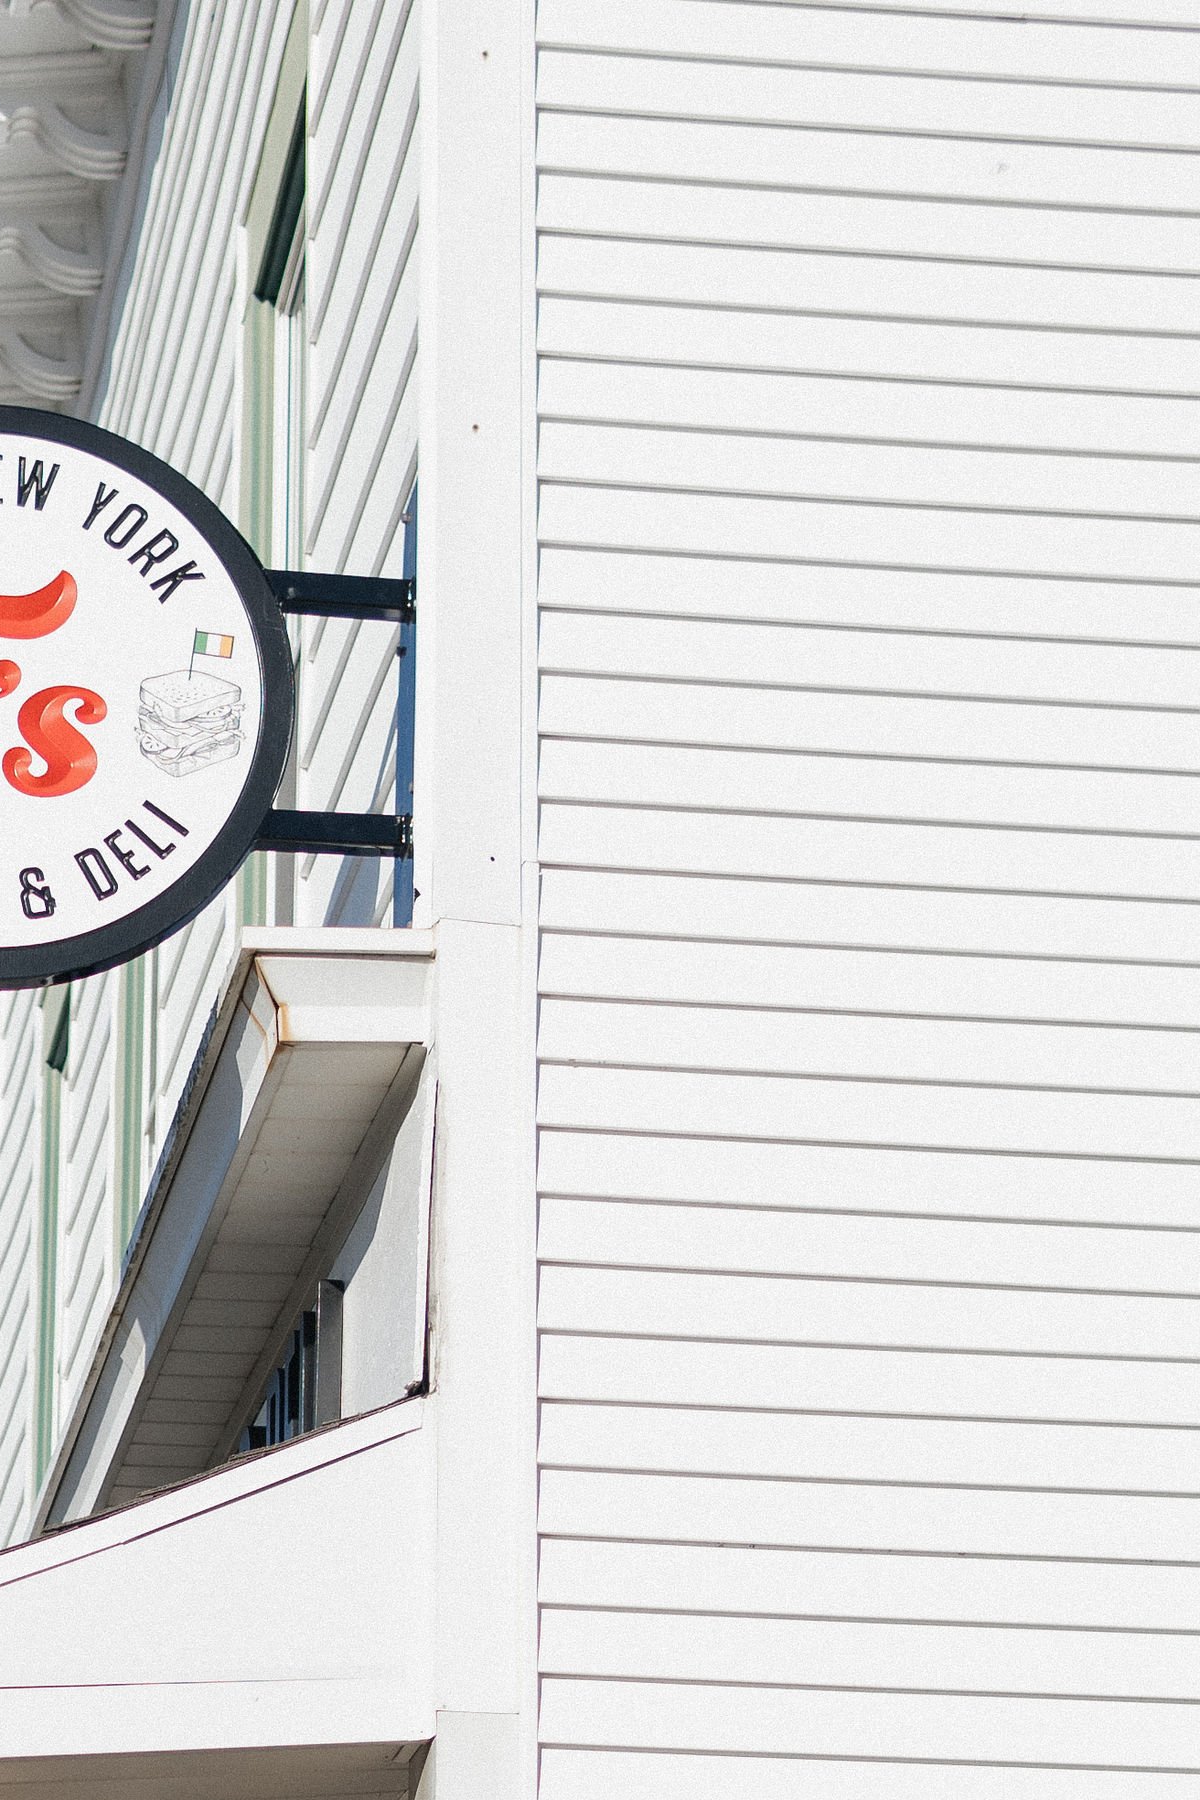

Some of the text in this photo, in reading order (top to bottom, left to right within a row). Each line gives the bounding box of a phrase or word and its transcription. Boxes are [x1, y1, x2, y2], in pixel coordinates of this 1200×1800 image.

[82, 482, 205, 604] YORK
[19, 867, 57, 920] &
[74, 800, 190, 901] DELI
